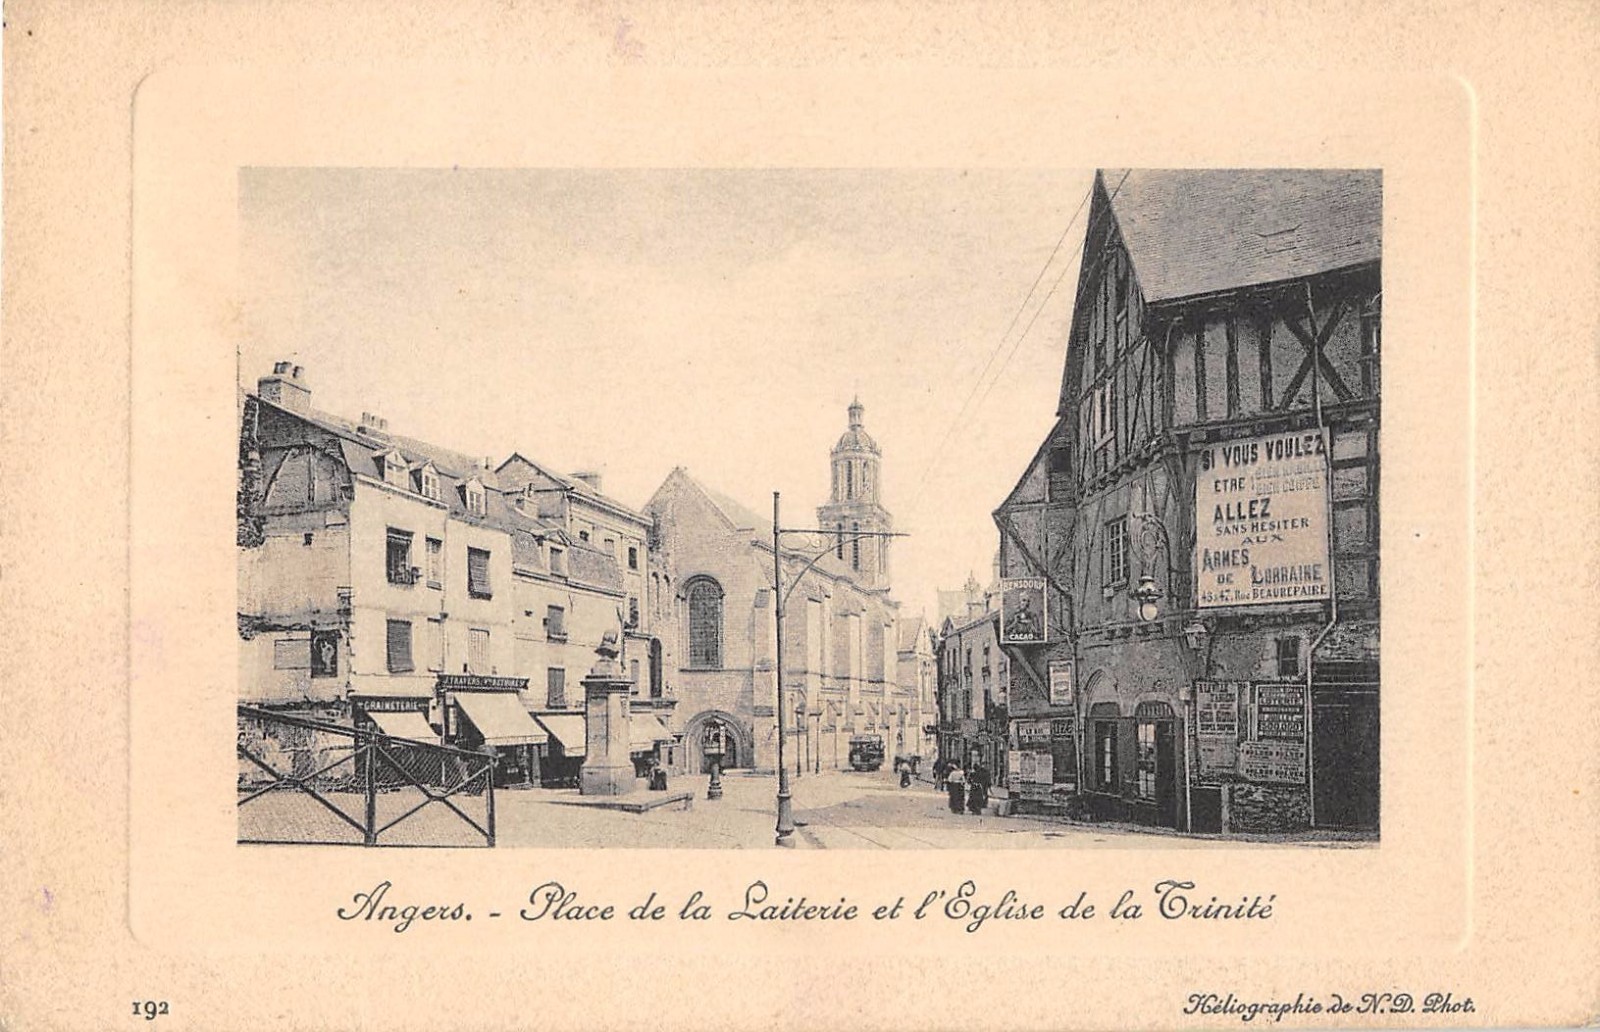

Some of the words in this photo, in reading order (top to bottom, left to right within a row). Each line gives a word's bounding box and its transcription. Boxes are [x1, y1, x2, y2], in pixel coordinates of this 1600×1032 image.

[1202, 449, 1216, 472] SI
[1223, 443, 1259, 467] VOUS
[1266, 434, 1326, 462] VOULEZ
[1214, 477, 1246, 493] ETRE
[1213, 498, 1271, 525] ALLEZ
[1216, 524, 1248, 537] SANS
[1251, 518, 1310, 533] HESITER
[1240, 533, 1284, 546] AUX
[1216, 573, 1234, 585] DE
[1251, 563, 1322, 587] LORRAINE
[1003, 579, 1045, 591] BENSDORP
[1235, 589, 1250, 600] Rue
[1252, 584, 1327, 600] BEAUREPAIRE
[364, 700, 418, 711] GRAINETERIE
